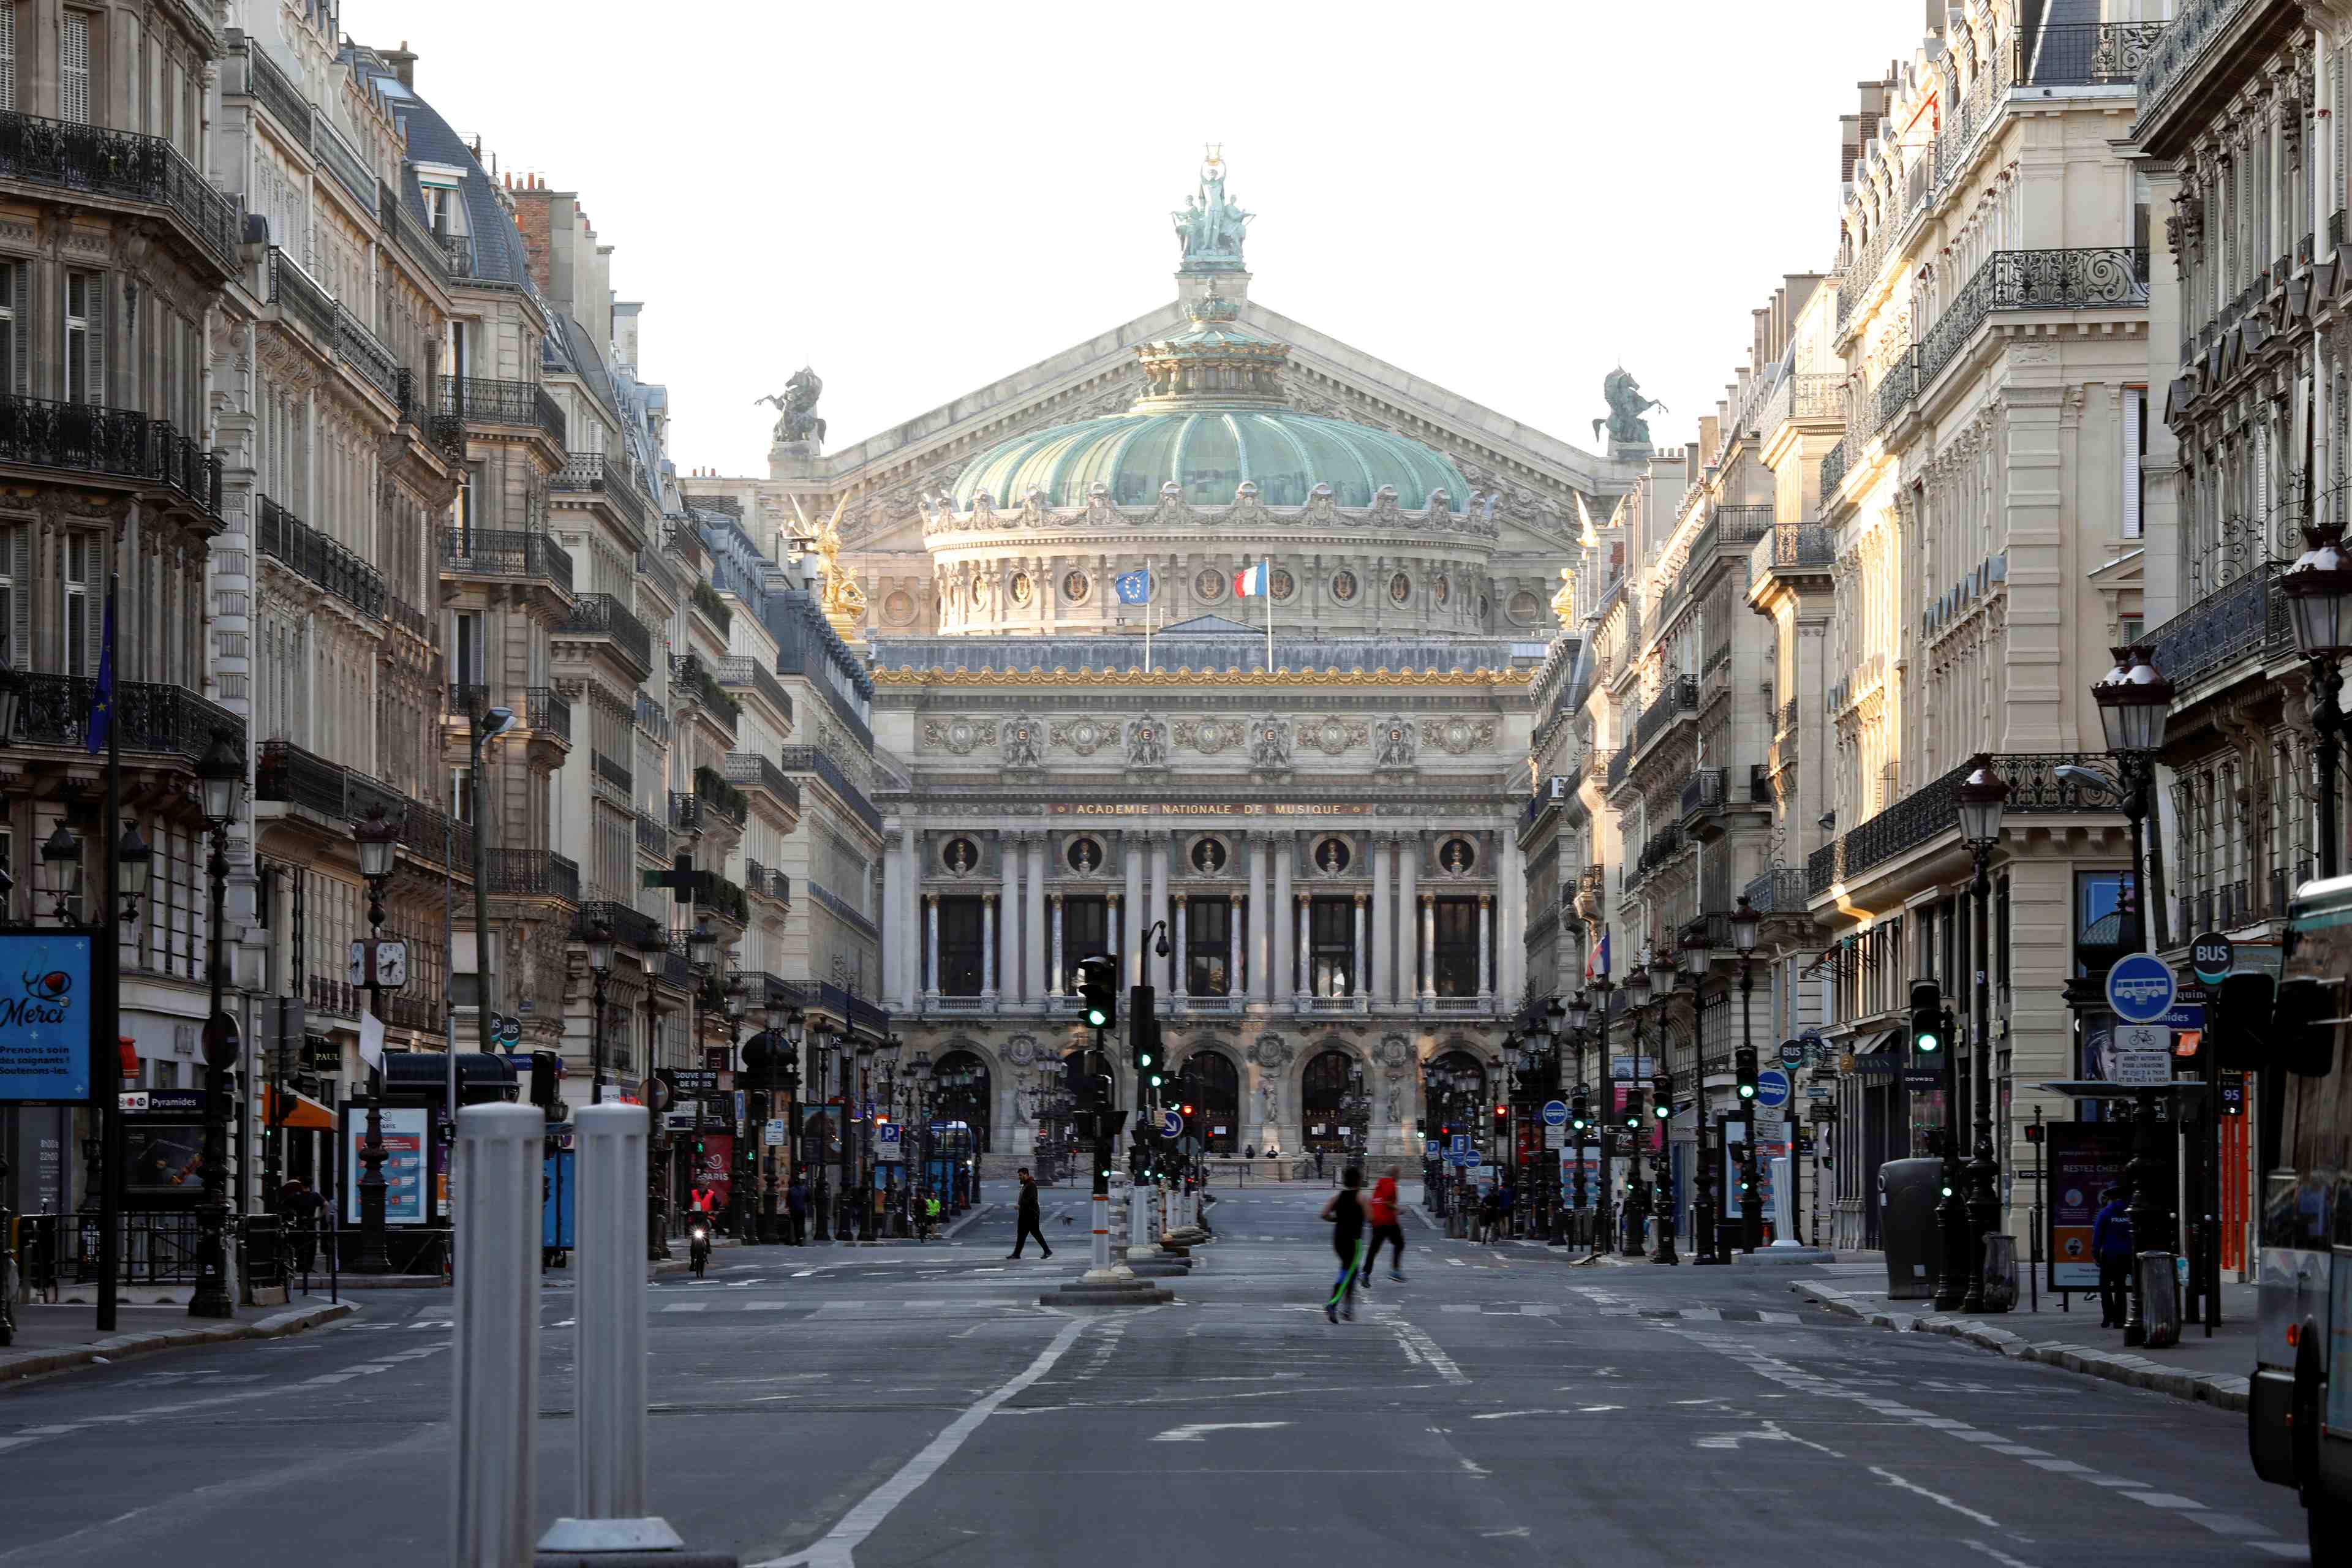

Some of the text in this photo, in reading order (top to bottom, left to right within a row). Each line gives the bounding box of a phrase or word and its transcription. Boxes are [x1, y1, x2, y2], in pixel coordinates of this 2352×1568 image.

[956, 730, 965, 739] N
[1019, 731, 1026, 740] E
[1081, 730, 1089, 739] N
[1143, 731, 1150, 740] E
[1205, 730, 1213, 739] N
[1267, 731, 1275, 740] E
[1329, 730, 1337, 739] N
[1391, 731, 1398, 740] E
[1453, 730, 1461, 739] N
[1077, 804, 1341, 815] ACADEMIE NATIONALE DE MUSIQUE
[2196, 945, 2228, 962] BUS
[0, 997, 65, 1028] Merci
[1783, 1047, 1801, 1056] BUS
[17, 1057, 64, 1066] soignants
[2224, 1089, 2240, 1101] 95
[151, 1098, 197, 1107] Pyramides
